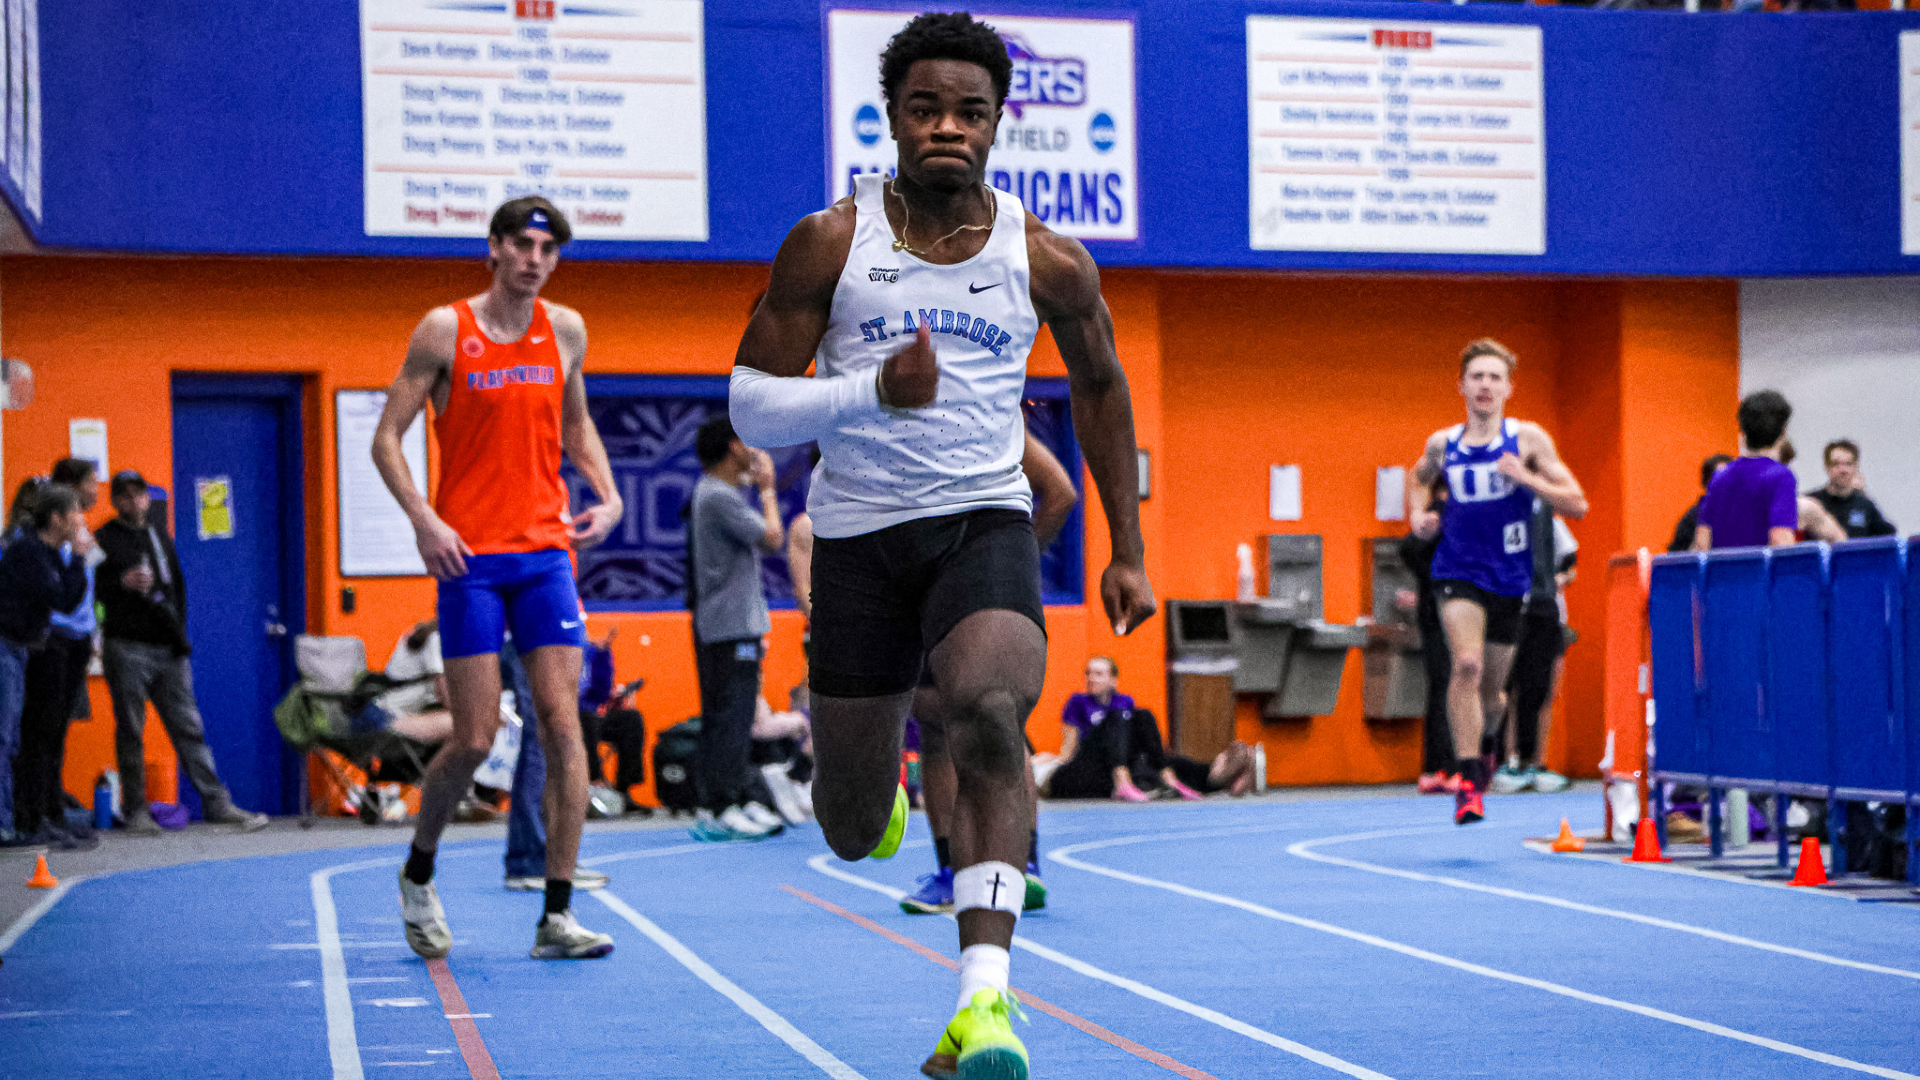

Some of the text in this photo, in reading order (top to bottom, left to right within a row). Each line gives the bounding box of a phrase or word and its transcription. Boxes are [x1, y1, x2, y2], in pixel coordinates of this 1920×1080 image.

[1006, 126, 1069, 153] FIELD
[860, 309, 1012, 357] ST. AMBROSE
